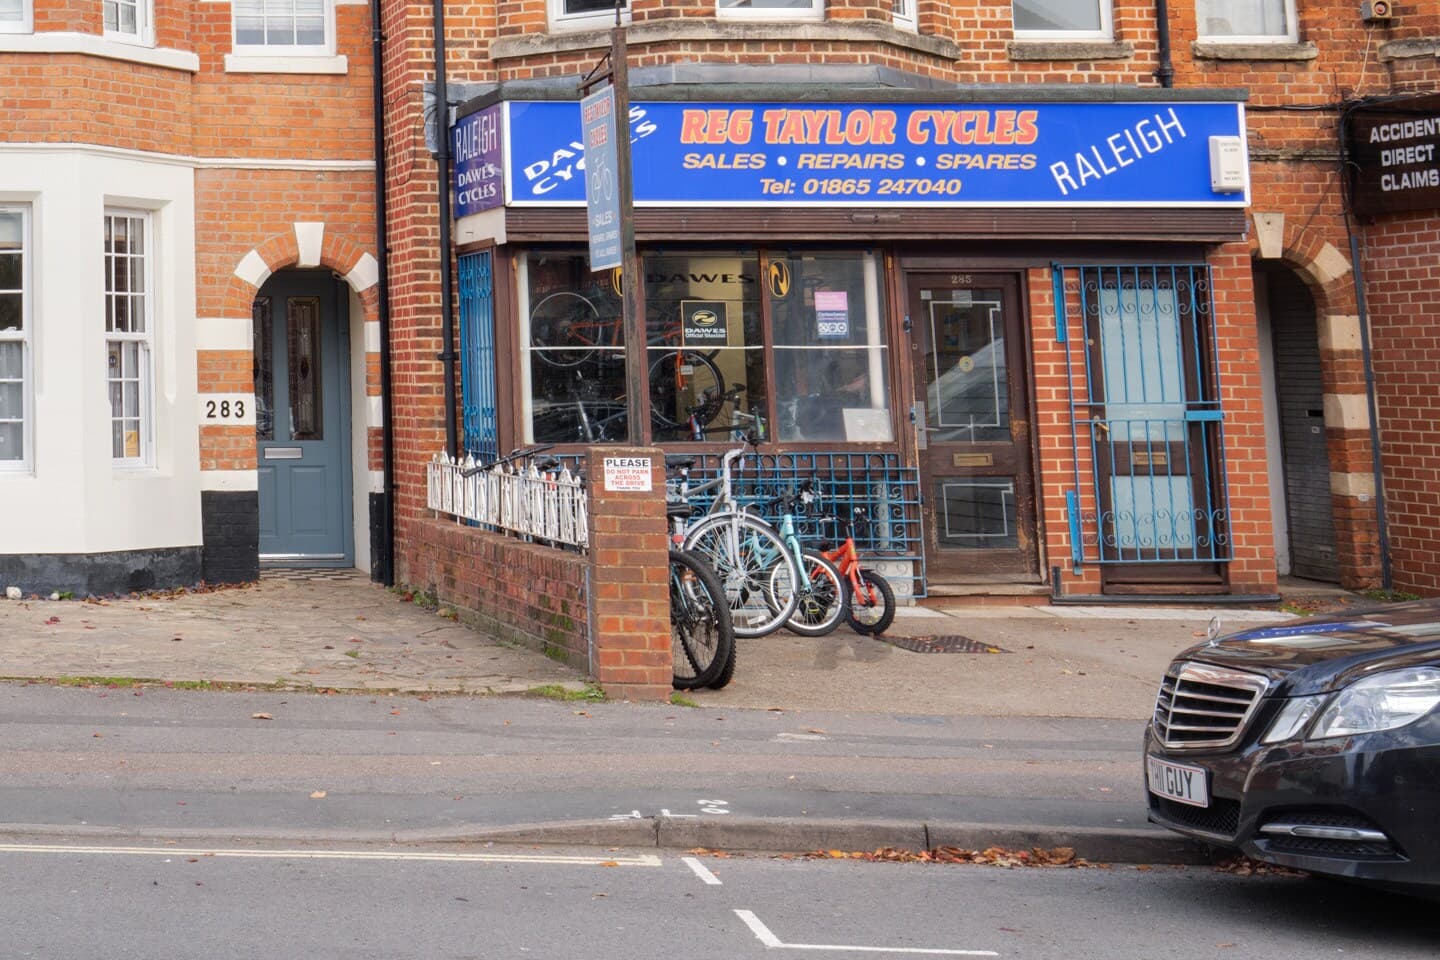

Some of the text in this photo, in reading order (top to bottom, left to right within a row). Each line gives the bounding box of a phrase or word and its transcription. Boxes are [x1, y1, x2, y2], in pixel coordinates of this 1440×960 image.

[680, 108, 1039, 145] REG TAYLOR CYCLES
[455, 112, 497, 164] RALEIGH
[682, 153, 1038, 169] SALES REPAIRS SPARES
[1049, 107, 1187, 196] RALEIGH
[1381, 144, 1435, 167] DIRECT
[760, 178, 962, 195] Tel: 01865 247040
[1381, 169, 1440, 192] CLAIMS
[458, 183, 497, 205] CYCLES
[646, 273, 755, 284] DAWES
[206, 400, 245, 418] 283
[606, 459, 649, 467] PLEASE
[1166, 766, 1193, 800] GUY
